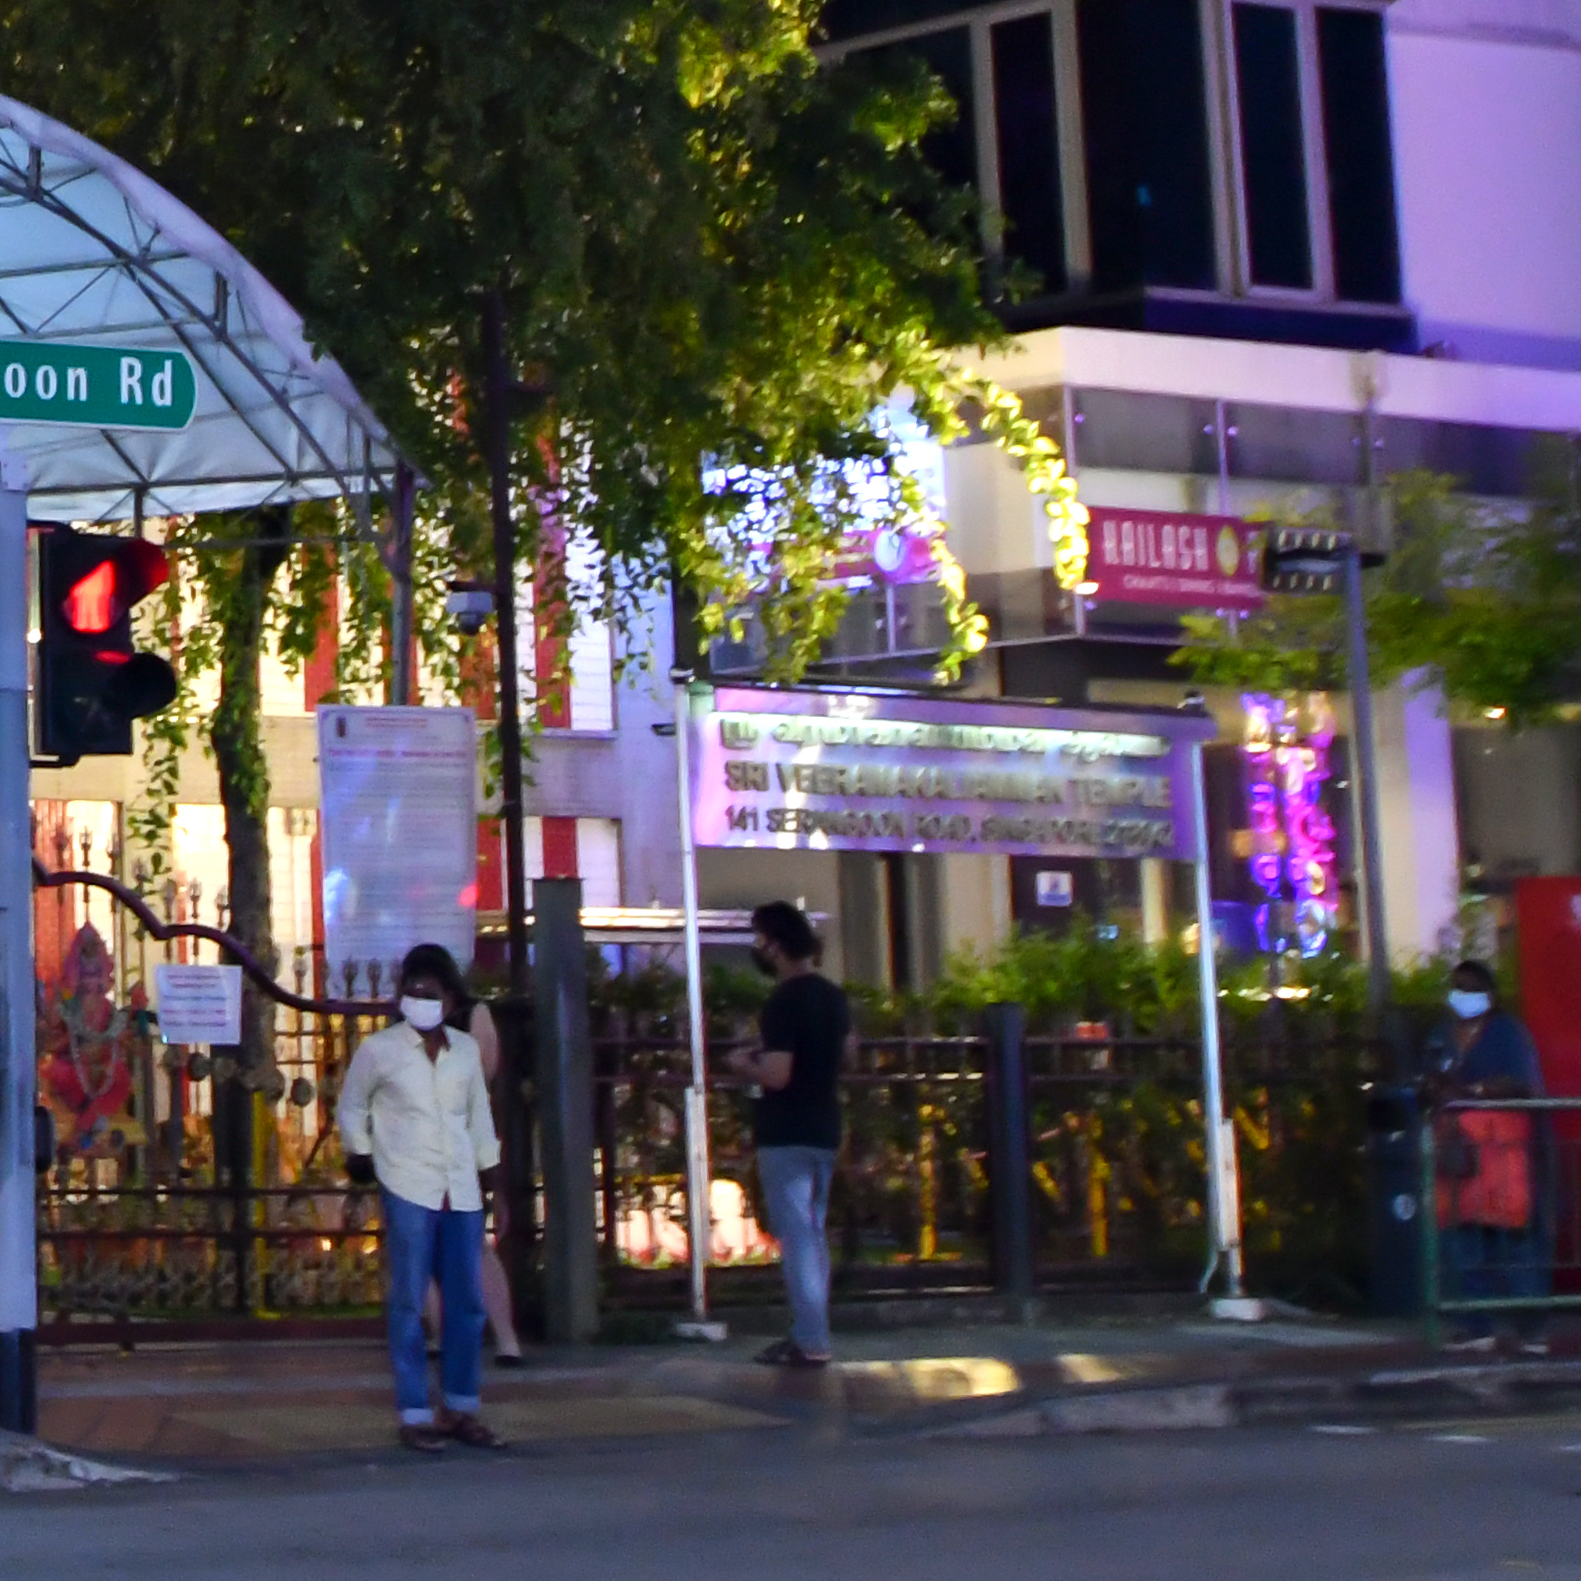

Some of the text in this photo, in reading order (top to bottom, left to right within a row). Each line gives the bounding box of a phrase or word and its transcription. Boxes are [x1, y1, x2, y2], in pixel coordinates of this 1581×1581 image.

[119, 356, 174, 407] Rd
[1102, 520, 1209, 573] KAILASH
[724, 760, 769, 792] SRI
[1067, 775, 1172, 809] TEMPLE
[725, 804, 759, 832] 141
